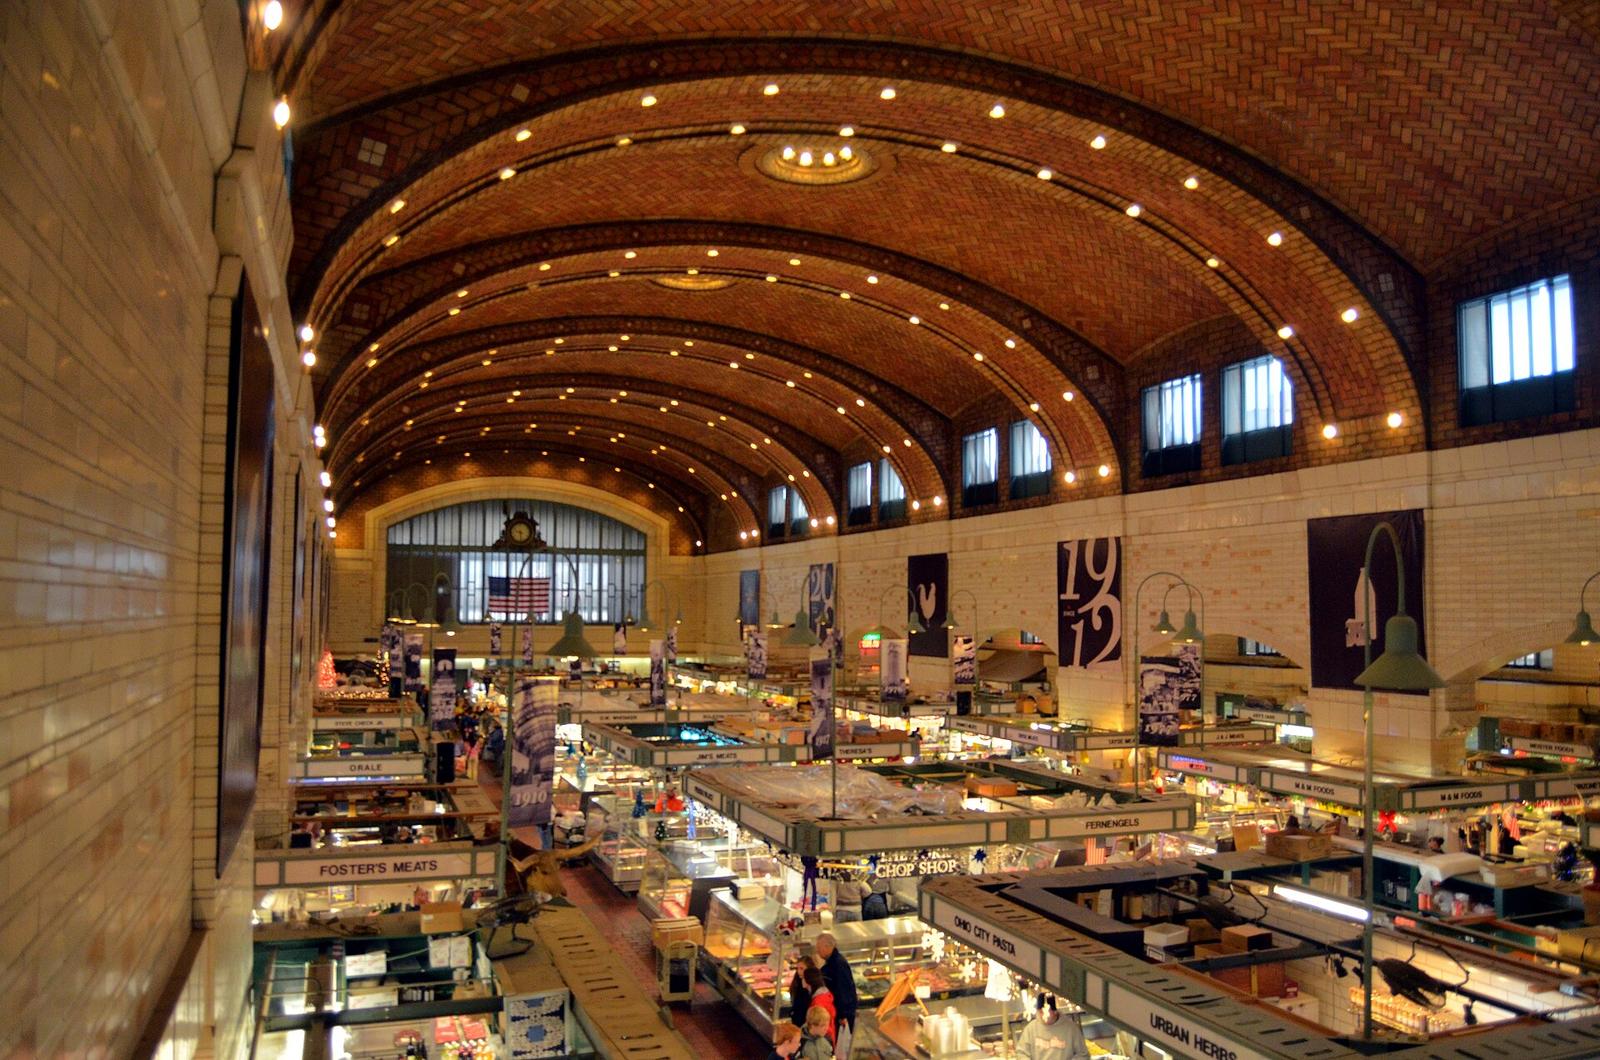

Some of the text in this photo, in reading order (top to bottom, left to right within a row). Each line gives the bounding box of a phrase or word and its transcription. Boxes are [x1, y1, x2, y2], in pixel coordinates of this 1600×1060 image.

[696, 753, 714, 761] JIM'S
[349, 764, 382, 772] ORALE
[1313, 785, 1335, 796] FOODS
[1461, 790, 1483, 799] FOODS
[1085, 818, 1139, 830] FERNENGELS
[320, 859, 438, 876] FOSTER'S MEATS
[875, 859, 956, 878] CHOP SHOP
[953, 915, 1016, 956] OHIO CITY PASTA
[1150, 1012, 1238, 1060] URBAN HERBS
